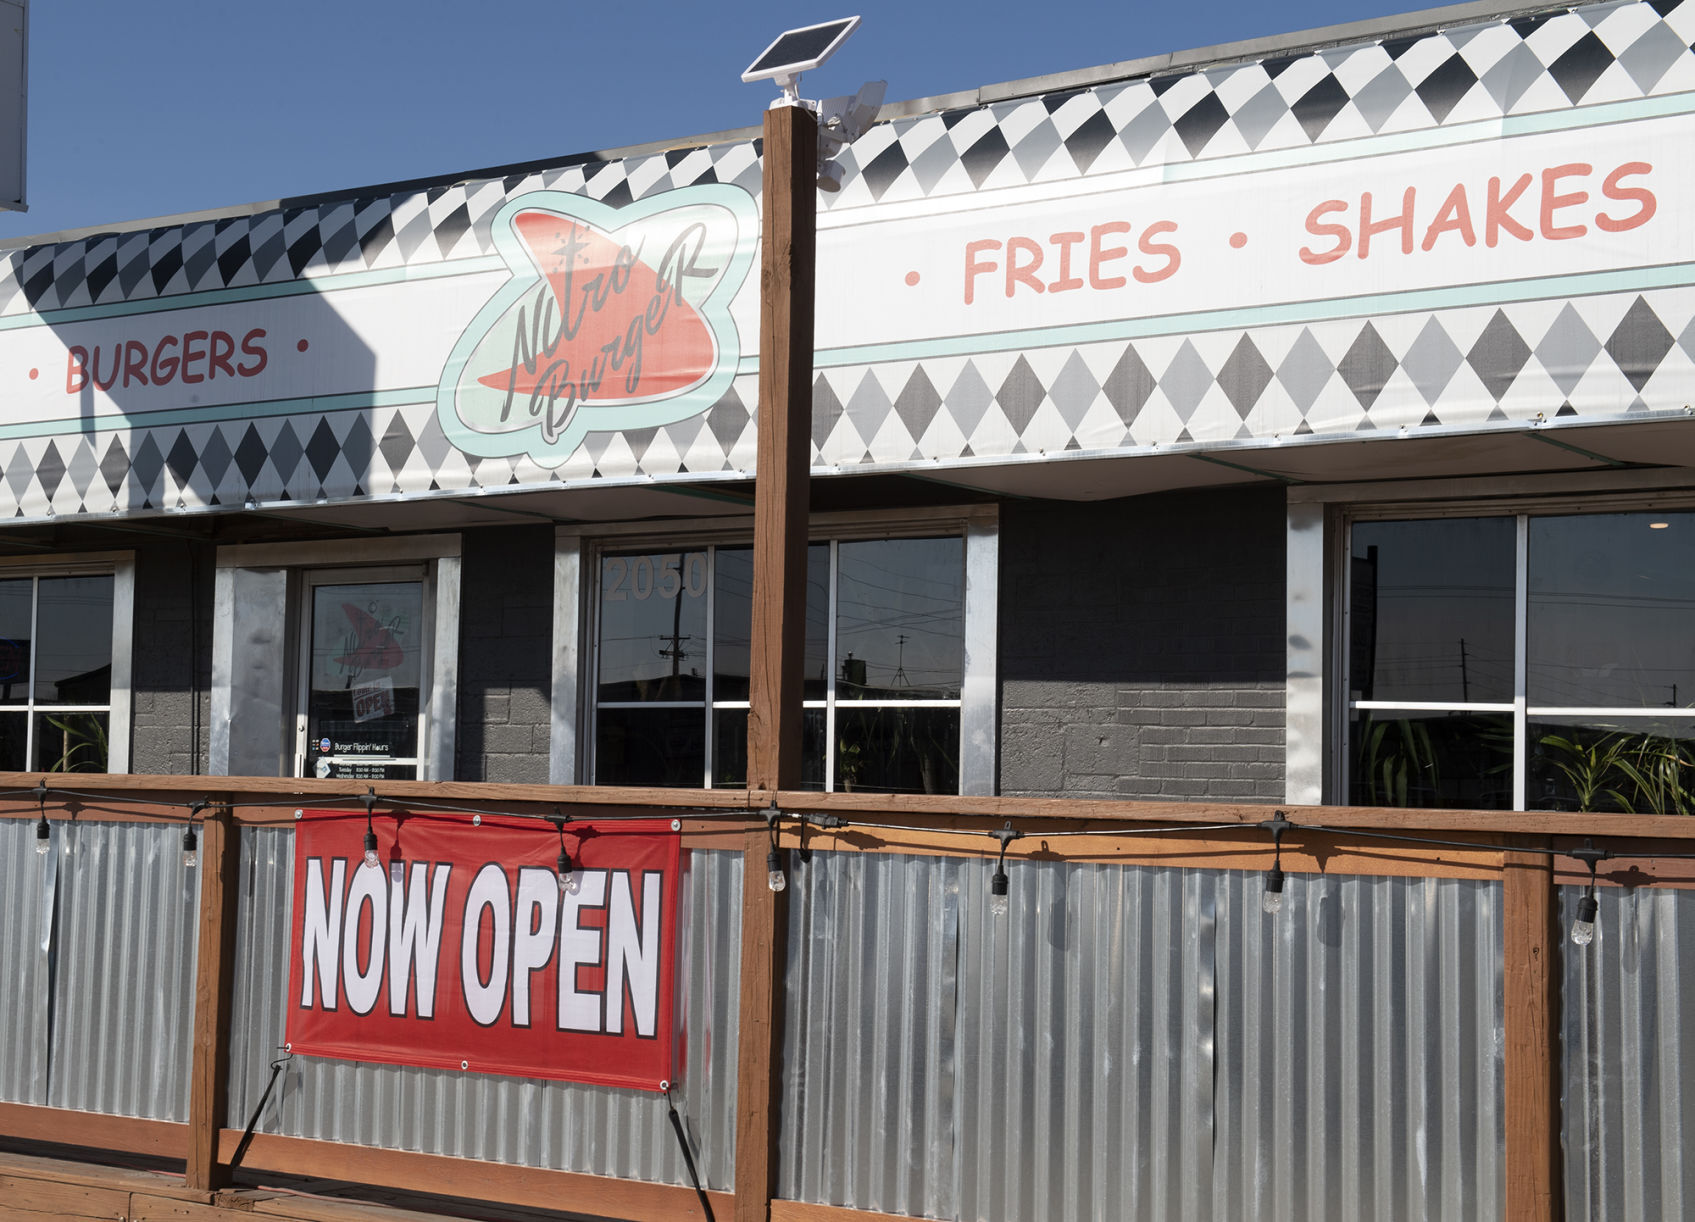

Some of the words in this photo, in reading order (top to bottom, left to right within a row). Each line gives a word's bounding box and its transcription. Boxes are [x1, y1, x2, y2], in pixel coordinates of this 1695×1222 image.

[964, 220, 1182, 306] FRIES
[1298, 161, 1658, 265] SHAKES
[66, 328, 268, 394] BURGERS
[500, 219, 646, 423] Nitro
[605, 551, 708, 602] 2050
[335, 743, 351, 752] Burger
[372, 743, 388, 751] Hours
[300, 856, 454, 1021] NOW
[460, 861, 665, 1040] OPEN
